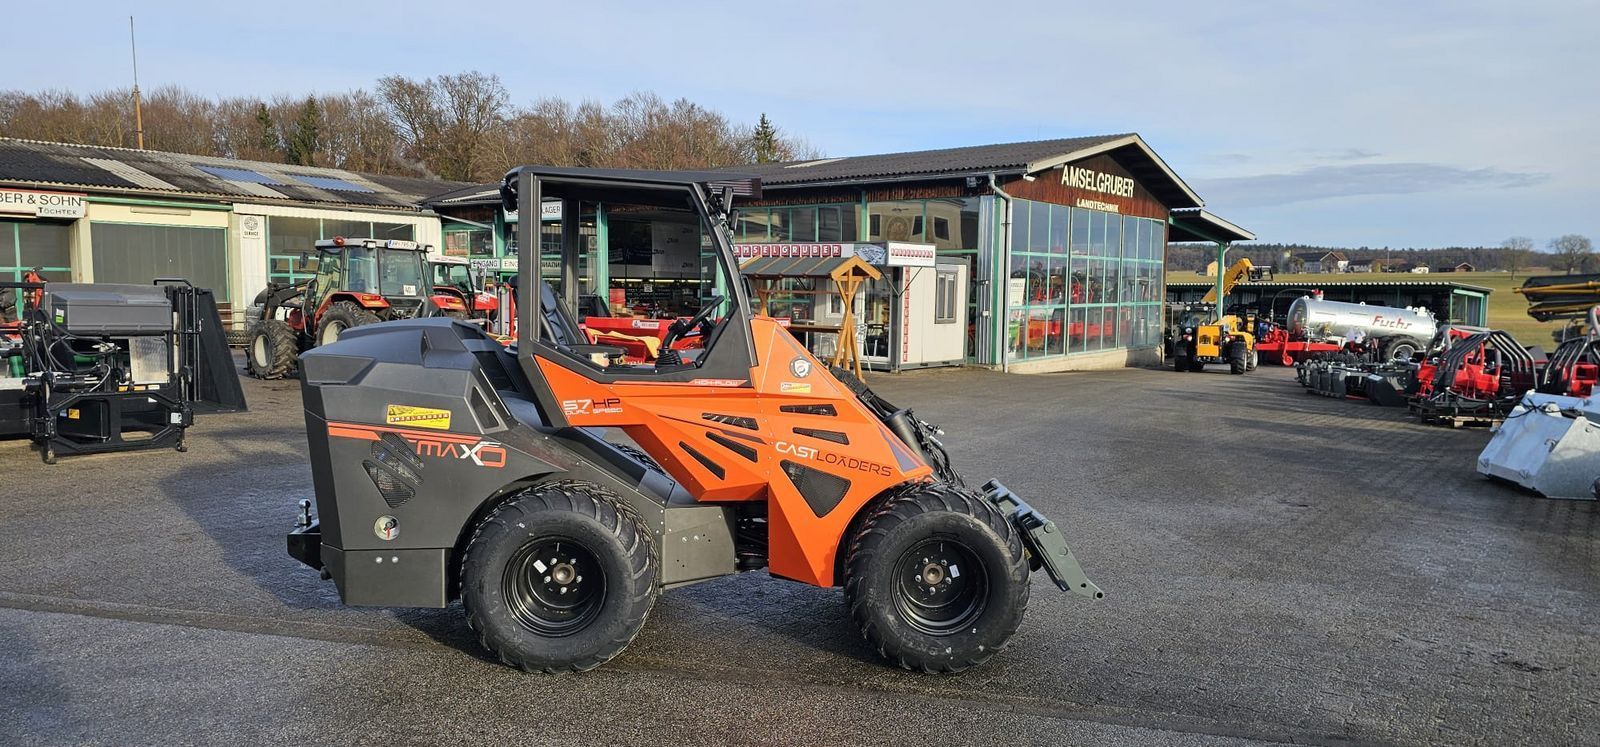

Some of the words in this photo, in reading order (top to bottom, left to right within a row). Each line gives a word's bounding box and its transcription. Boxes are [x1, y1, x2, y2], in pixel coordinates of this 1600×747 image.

[1061, 164, 1135, 198] AMSELGRUBER
[27, 194, 36, 204] &
[40, 195, 81, 206] SOHN
[1076, 198, 1119, 213] LANDTECHNIK
[1372, 315, 1413, 330] Fuchs
